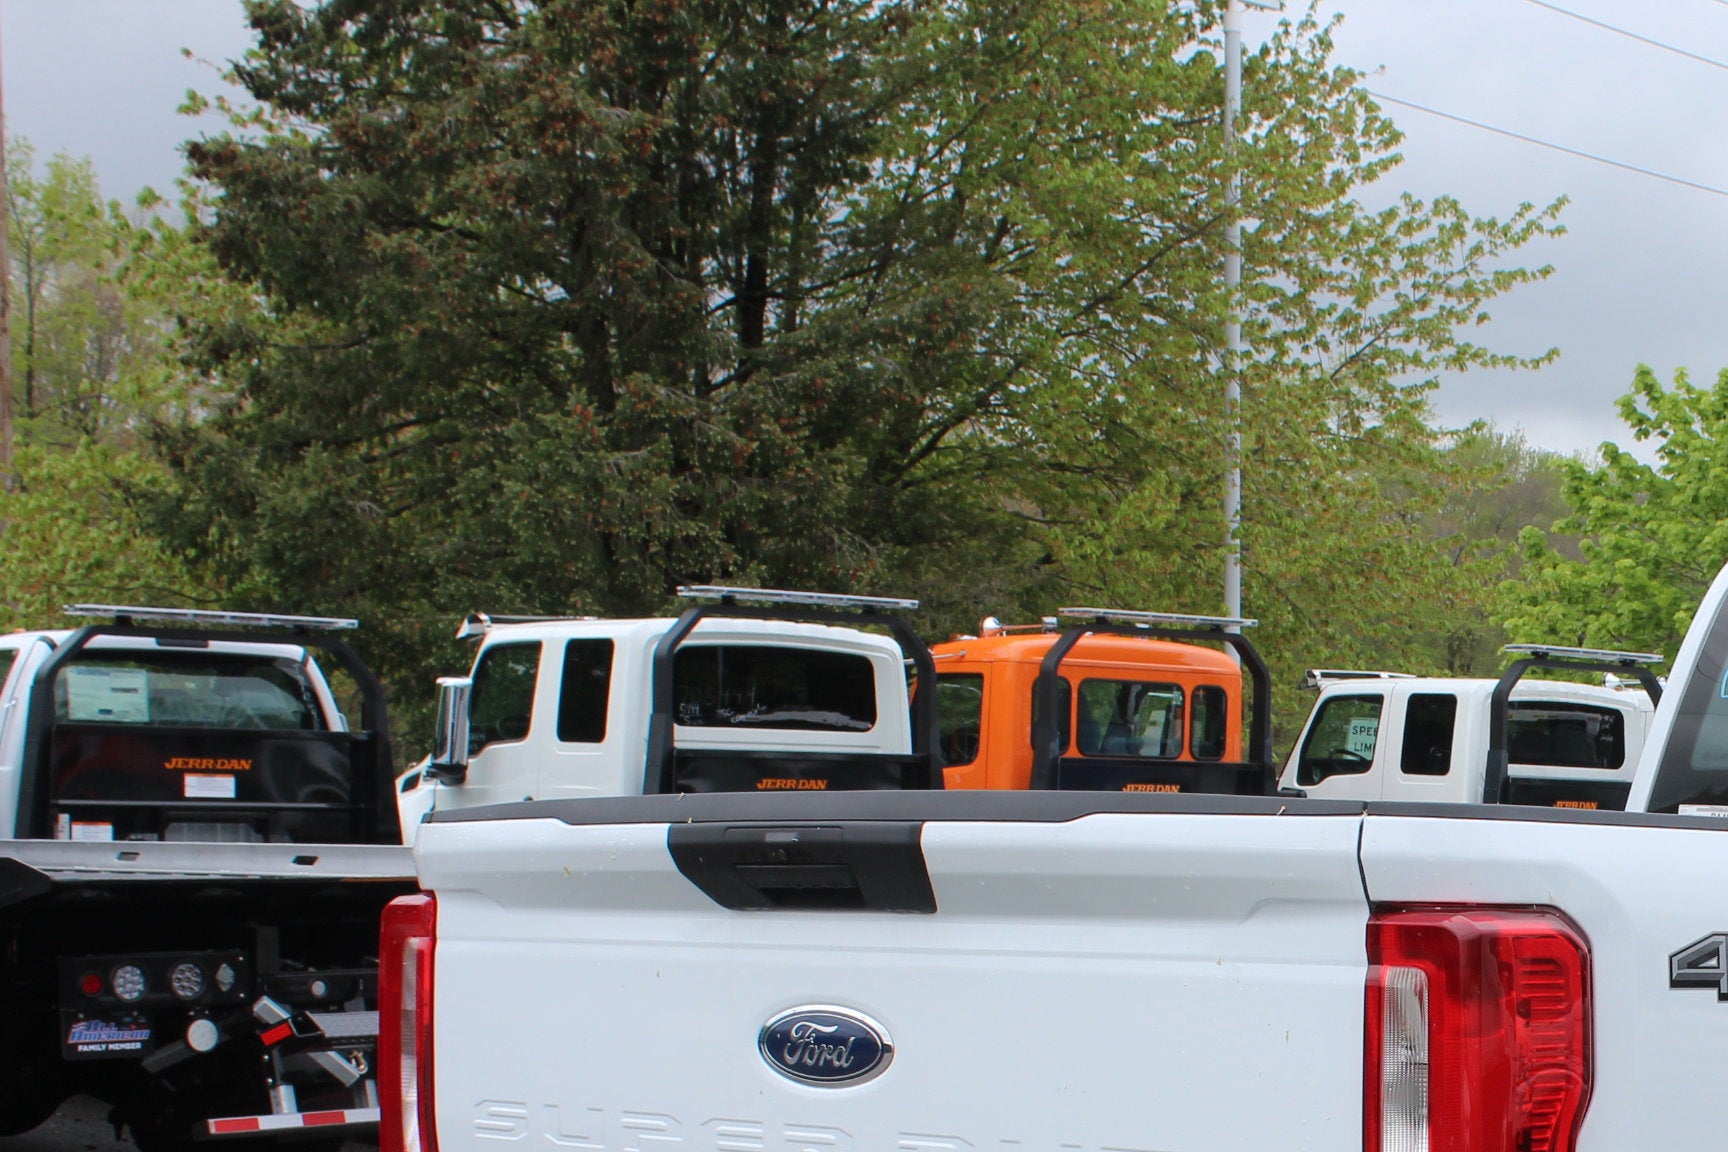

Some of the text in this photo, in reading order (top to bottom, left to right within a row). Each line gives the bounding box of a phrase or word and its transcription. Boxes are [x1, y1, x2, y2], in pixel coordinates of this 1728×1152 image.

[77, 1042, 142, 1052] FAMILY MEMBER
[783, 1021, 856, 1069] Ford
